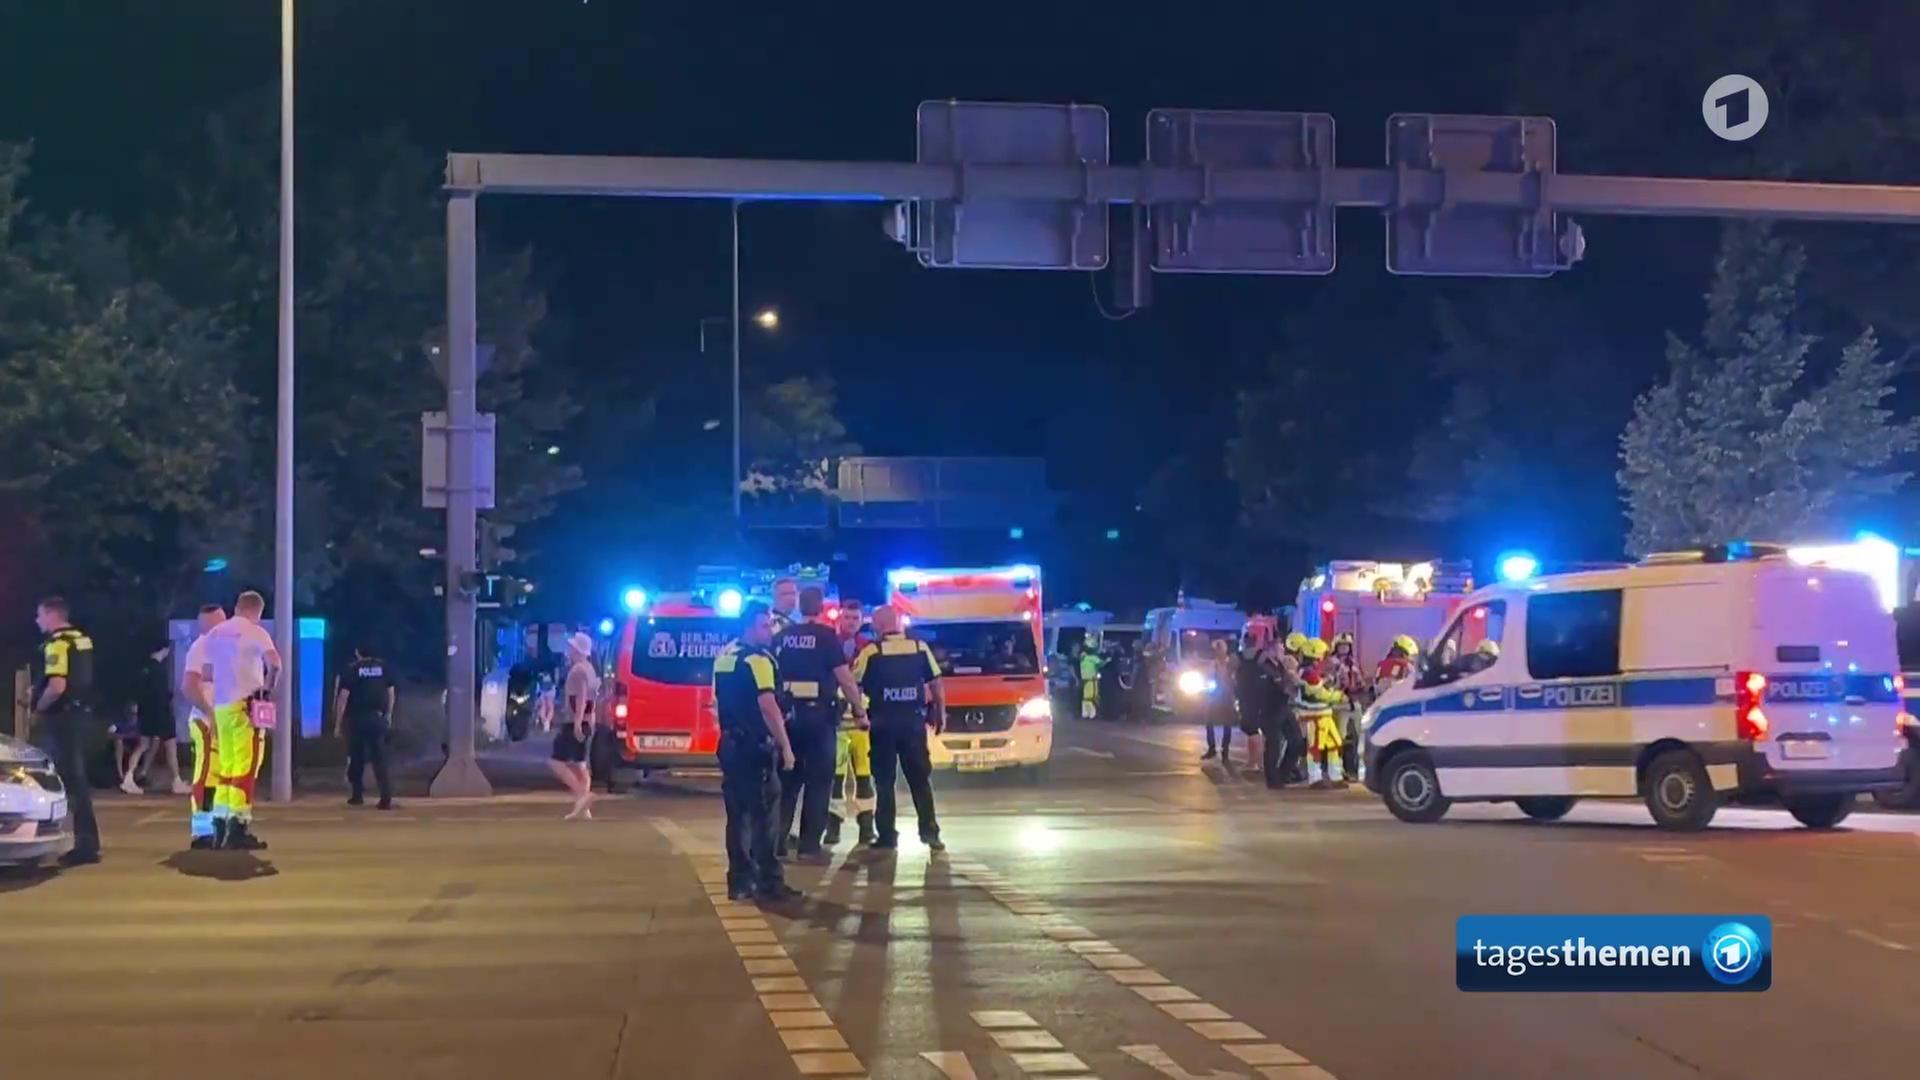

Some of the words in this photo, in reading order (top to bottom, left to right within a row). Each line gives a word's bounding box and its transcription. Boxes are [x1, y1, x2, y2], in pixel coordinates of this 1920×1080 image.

[783, 635, 816, 649] POLIZEI
[883, 687, 918, 702] POLIZEI
[1543, 684, 1614, 707] POLIZEI
[1769, 680, 1827, 698] POLIZEI
